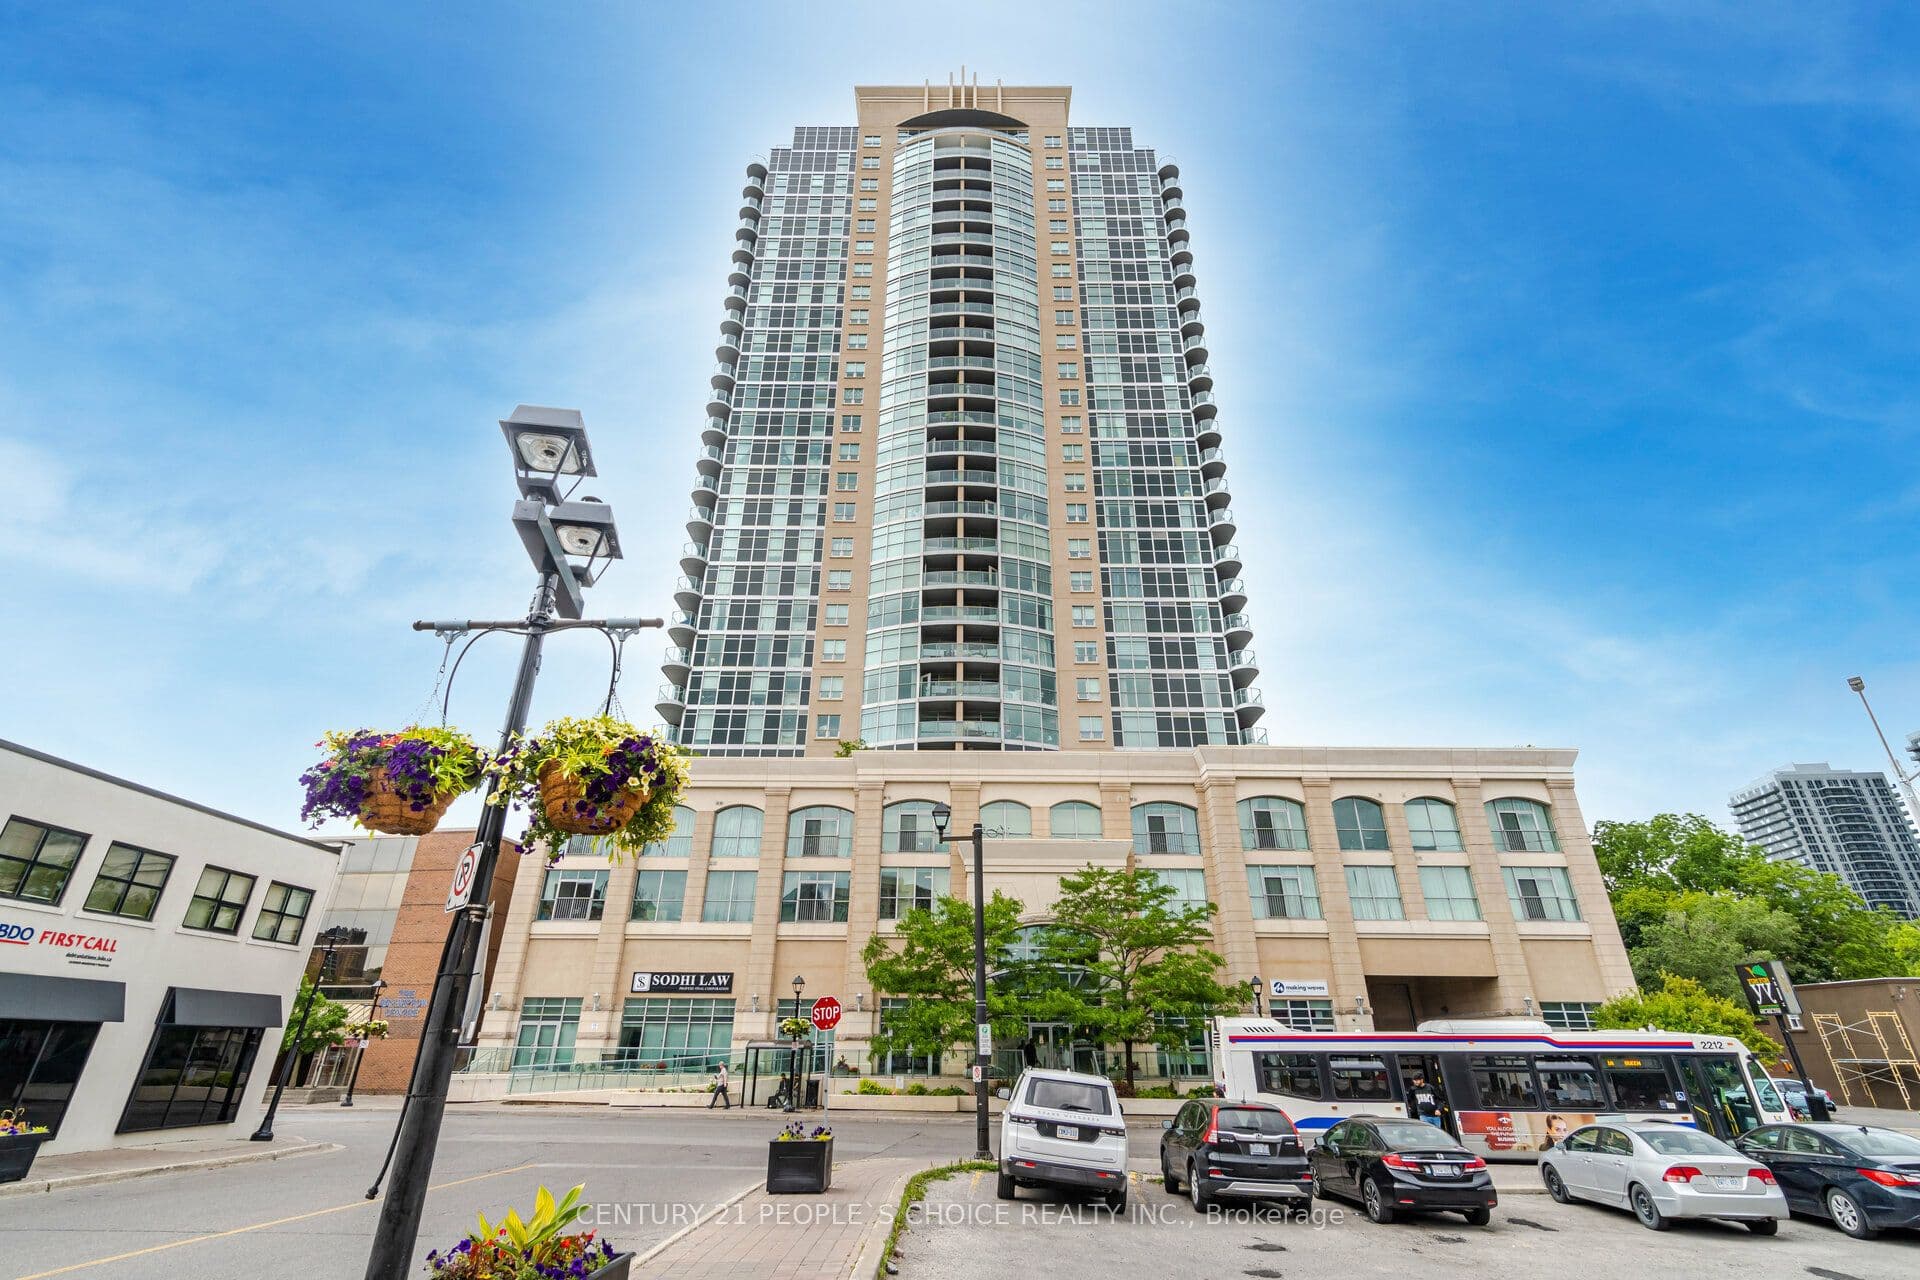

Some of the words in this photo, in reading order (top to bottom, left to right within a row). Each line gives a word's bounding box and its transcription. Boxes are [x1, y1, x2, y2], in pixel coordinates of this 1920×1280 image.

[0, 923, 35, 941] BDO
[651, 974, 697, 986] SODHI
[699, 974, 731, 986] LAW
[813, 1005, 840, 1021] STOP
[1701, 1041, 1724, 1049] 2212
